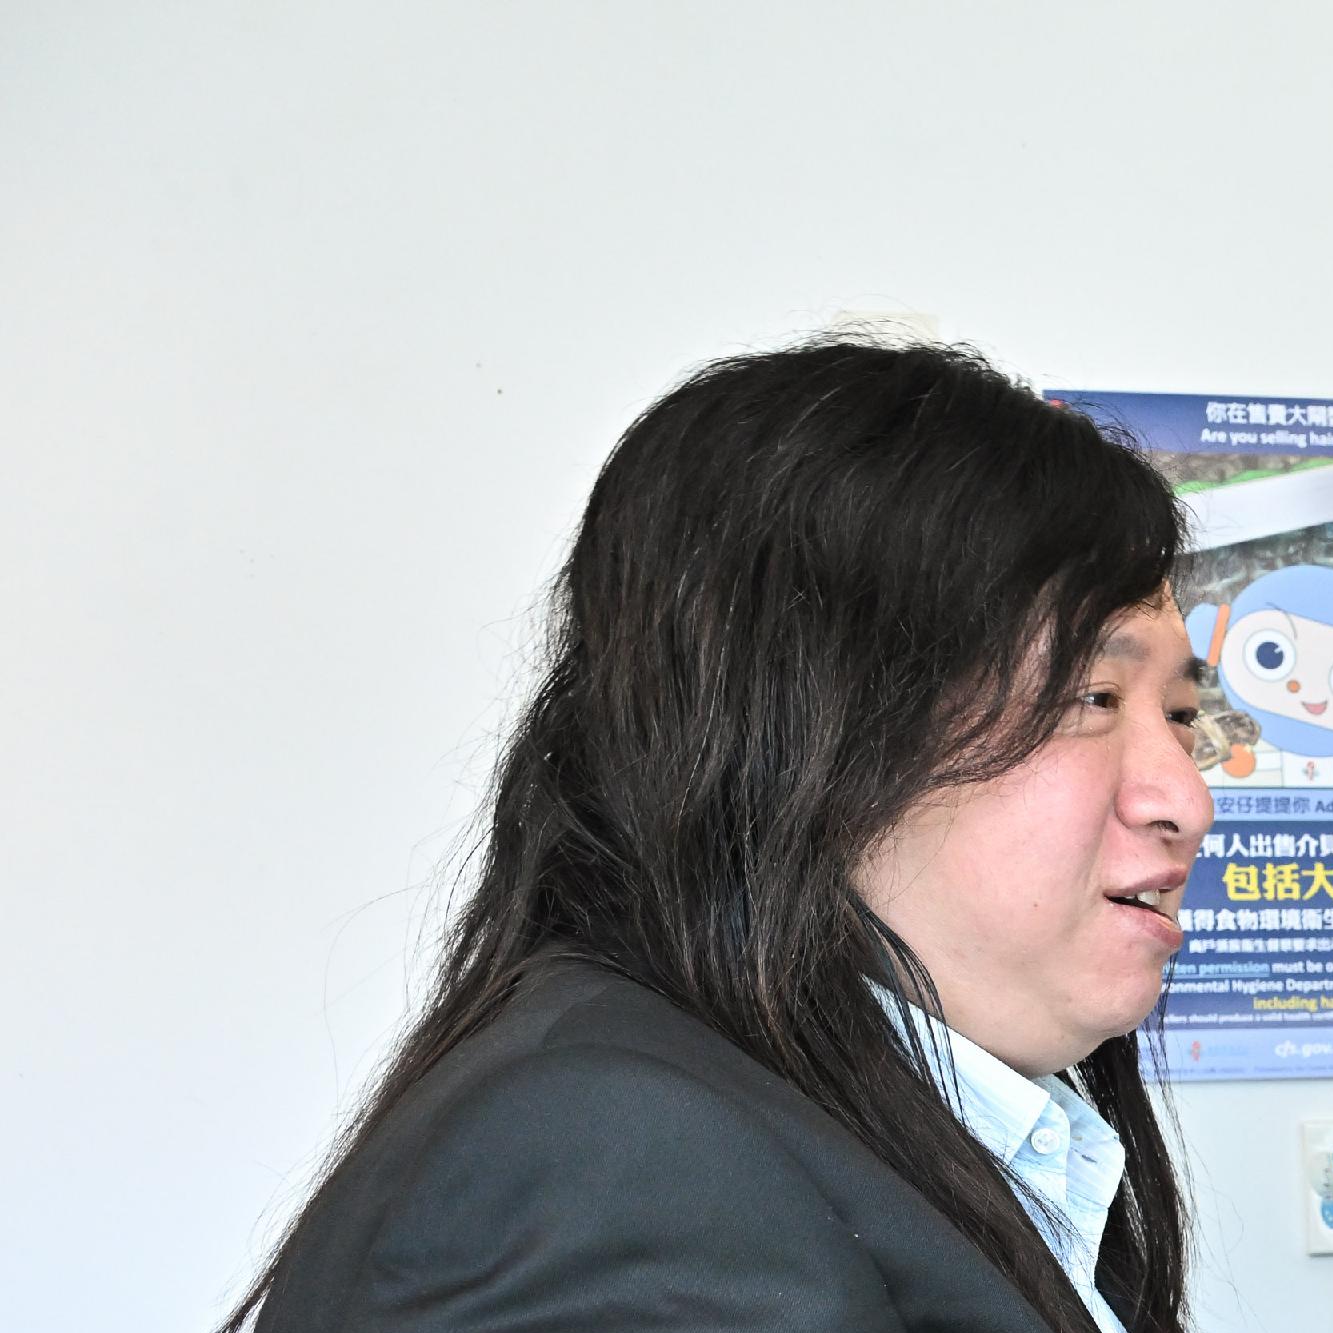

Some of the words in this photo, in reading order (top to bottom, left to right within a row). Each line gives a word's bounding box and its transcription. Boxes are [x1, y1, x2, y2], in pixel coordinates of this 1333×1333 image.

[1201, 428, 1226, 443] Are
[1230, 431, 1258, 446] you
[1261, 430, 1307, 448] selling
[1198, 961, 1270, 976] permission
[1272, 960, 1306, 974] must
[1306, 959, 1323, 973] be
[1231, 980, 1283, 995] Hygiene
[1254, 994, 1317, 1011] including
